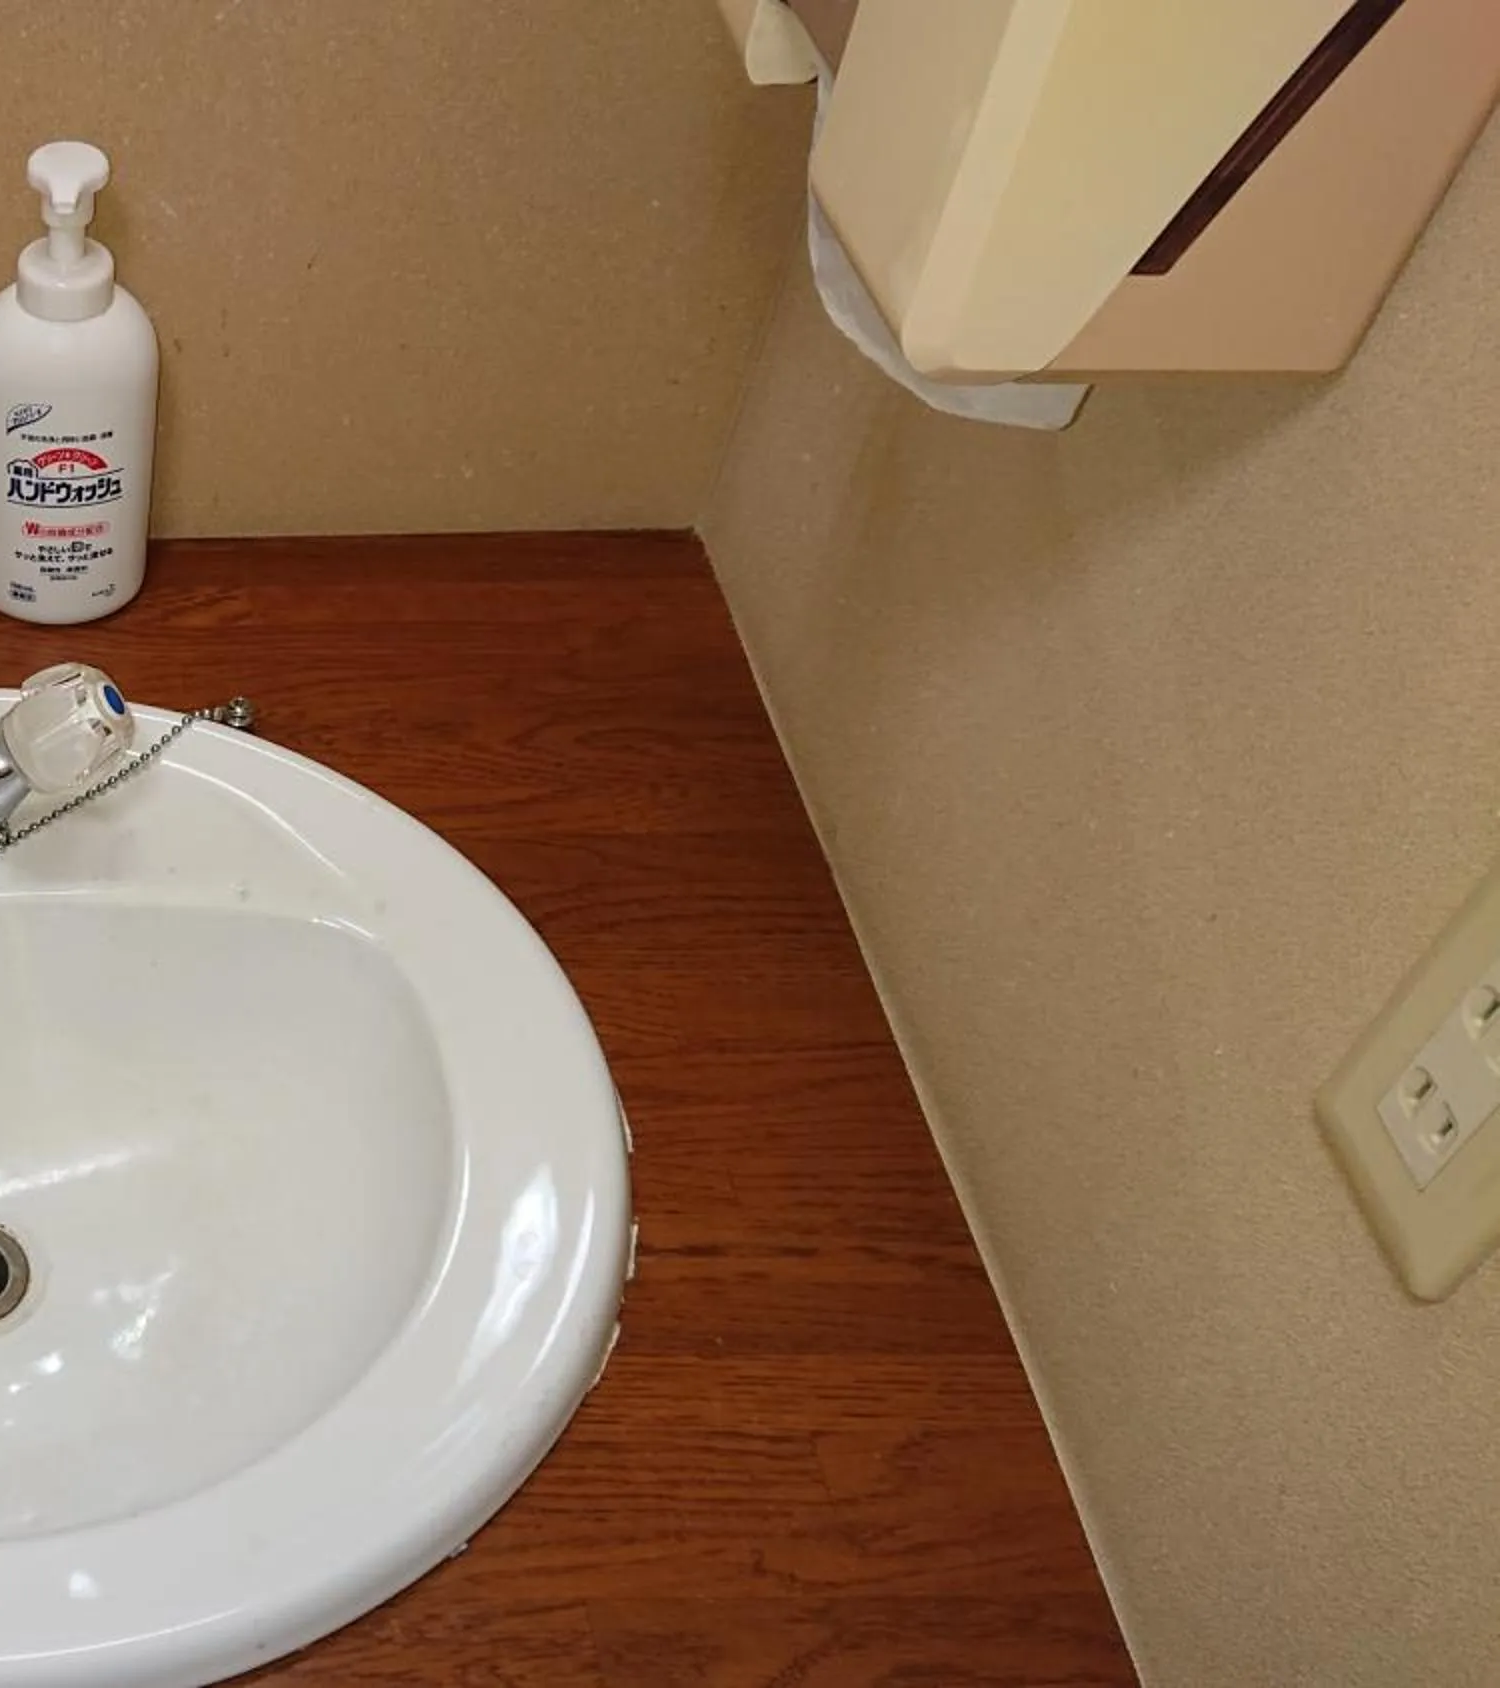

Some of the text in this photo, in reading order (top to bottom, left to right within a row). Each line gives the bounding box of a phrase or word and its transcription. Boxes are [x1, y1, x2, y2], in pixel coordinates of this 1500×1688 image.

[7, 477, 122, 503] ハンドウォッシュ
